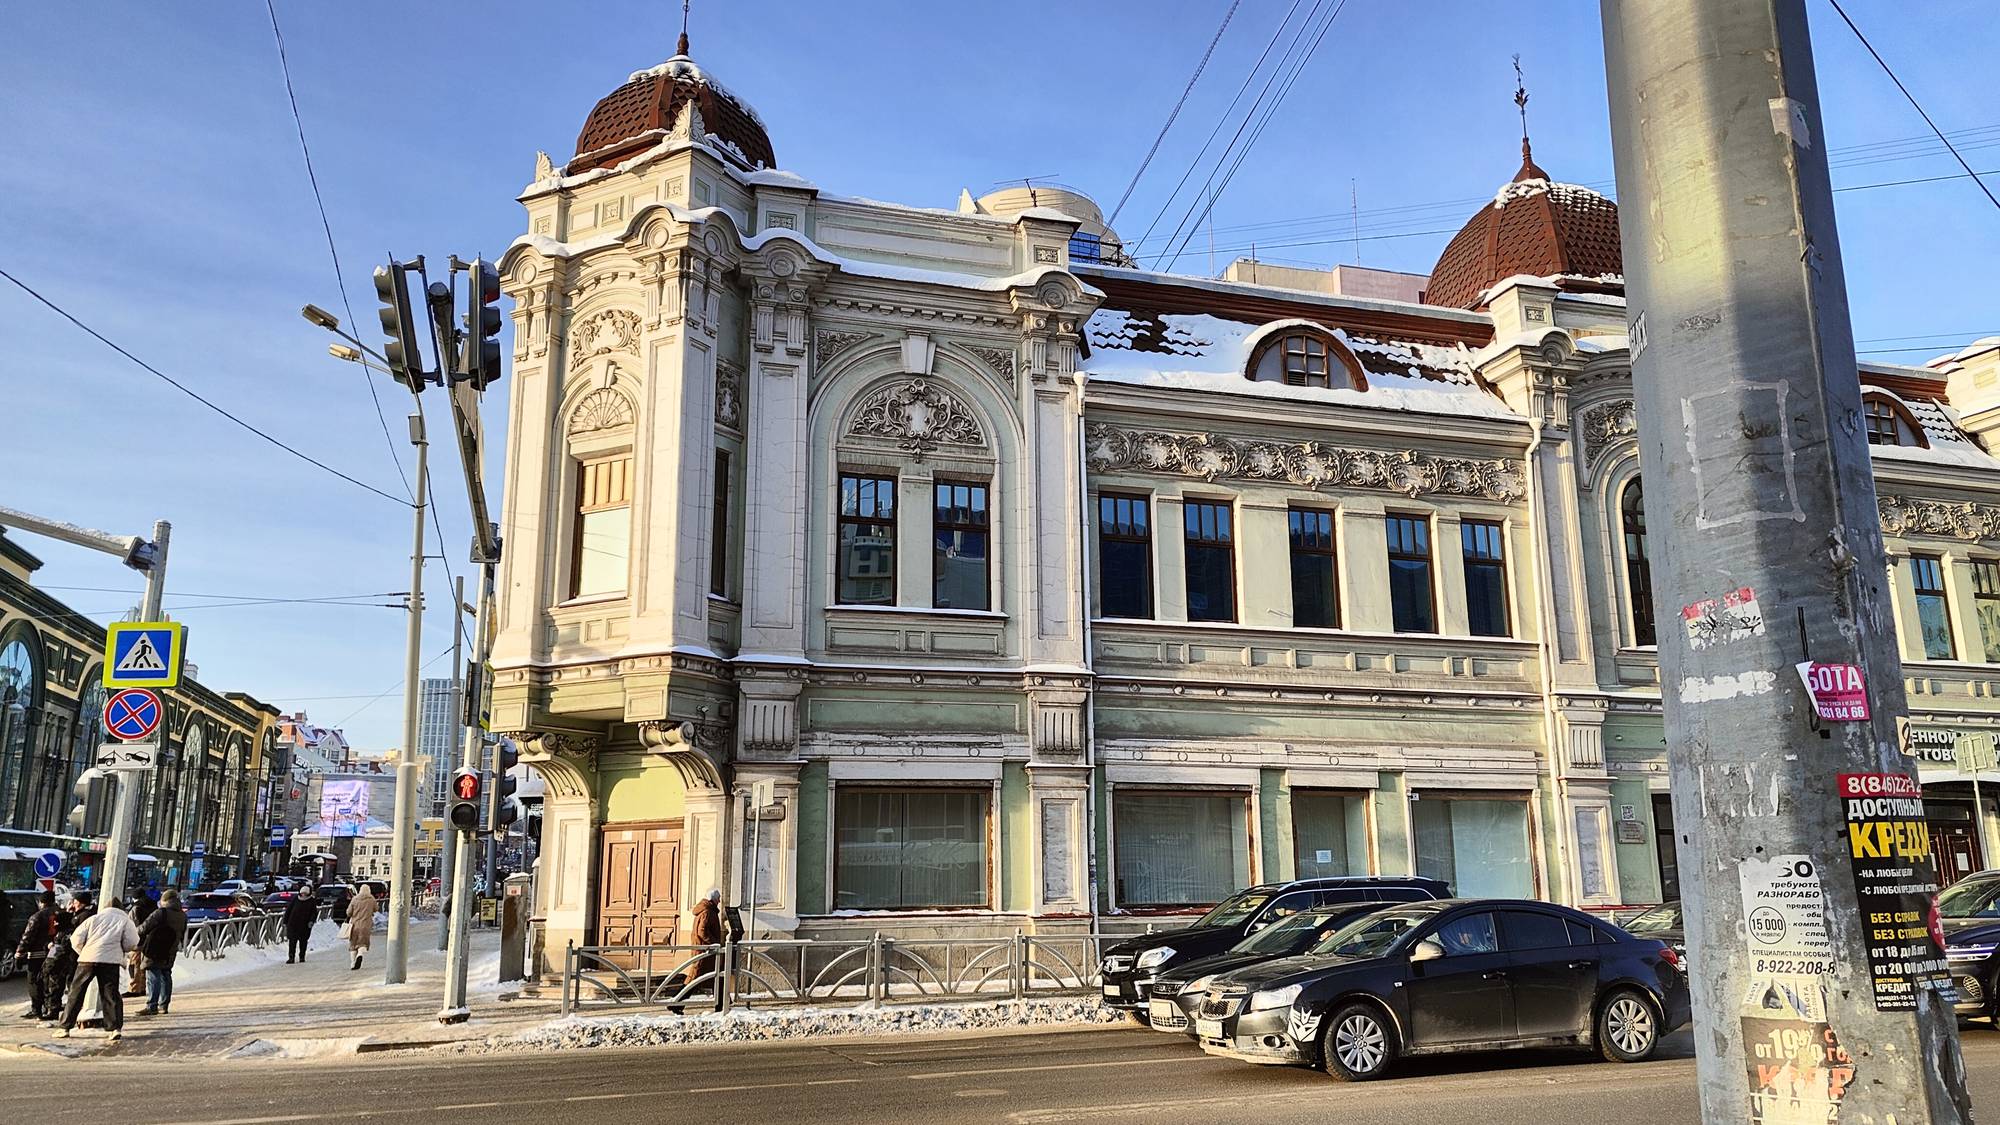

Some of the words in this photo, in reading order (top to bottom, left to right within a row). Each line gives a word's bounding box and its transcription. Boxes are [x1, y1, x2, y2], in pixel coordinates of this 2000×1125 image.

[1770, 881, 1820, 889] требуютс
[1861, 886, 1871, 895] -С
[1757, 890, 1820, 898] РАЗНОРАБО
[1870, 912, 1892, 924] БЕЗ
[1752, 918, 1762, 930] 15
[1765, 918, 1784, 930] 000
[1873, 929, 1895, 940] БЕЗ
[1752, 949, 1802, 957] СПЕЦИАЛИСТАМ
[1886, 946, 1898, 958] 18
[1888, 962, 1902, 975] 20
[1876, 982, 1912, 994] КРЕДИТ
